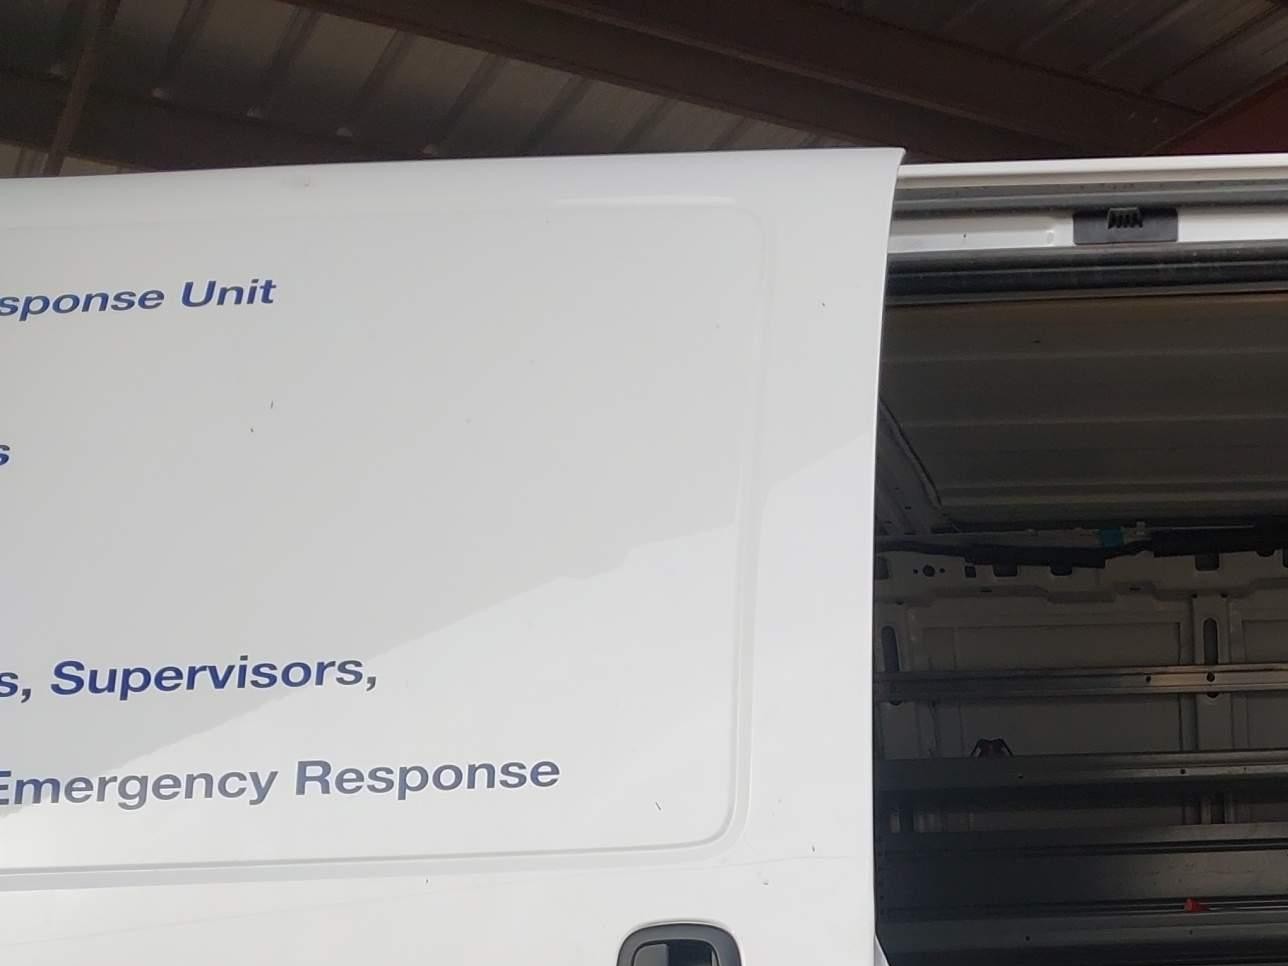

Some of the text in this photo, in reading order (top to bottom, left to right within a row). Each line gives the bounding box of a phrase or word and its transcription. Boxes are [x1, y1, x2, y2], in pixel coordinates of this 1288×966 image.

[0, 278, 278, 322] sponse Unit
[0, 654, 377, 704] s, Supervisors,
[0, 759, 561, 811] Emergency Response
